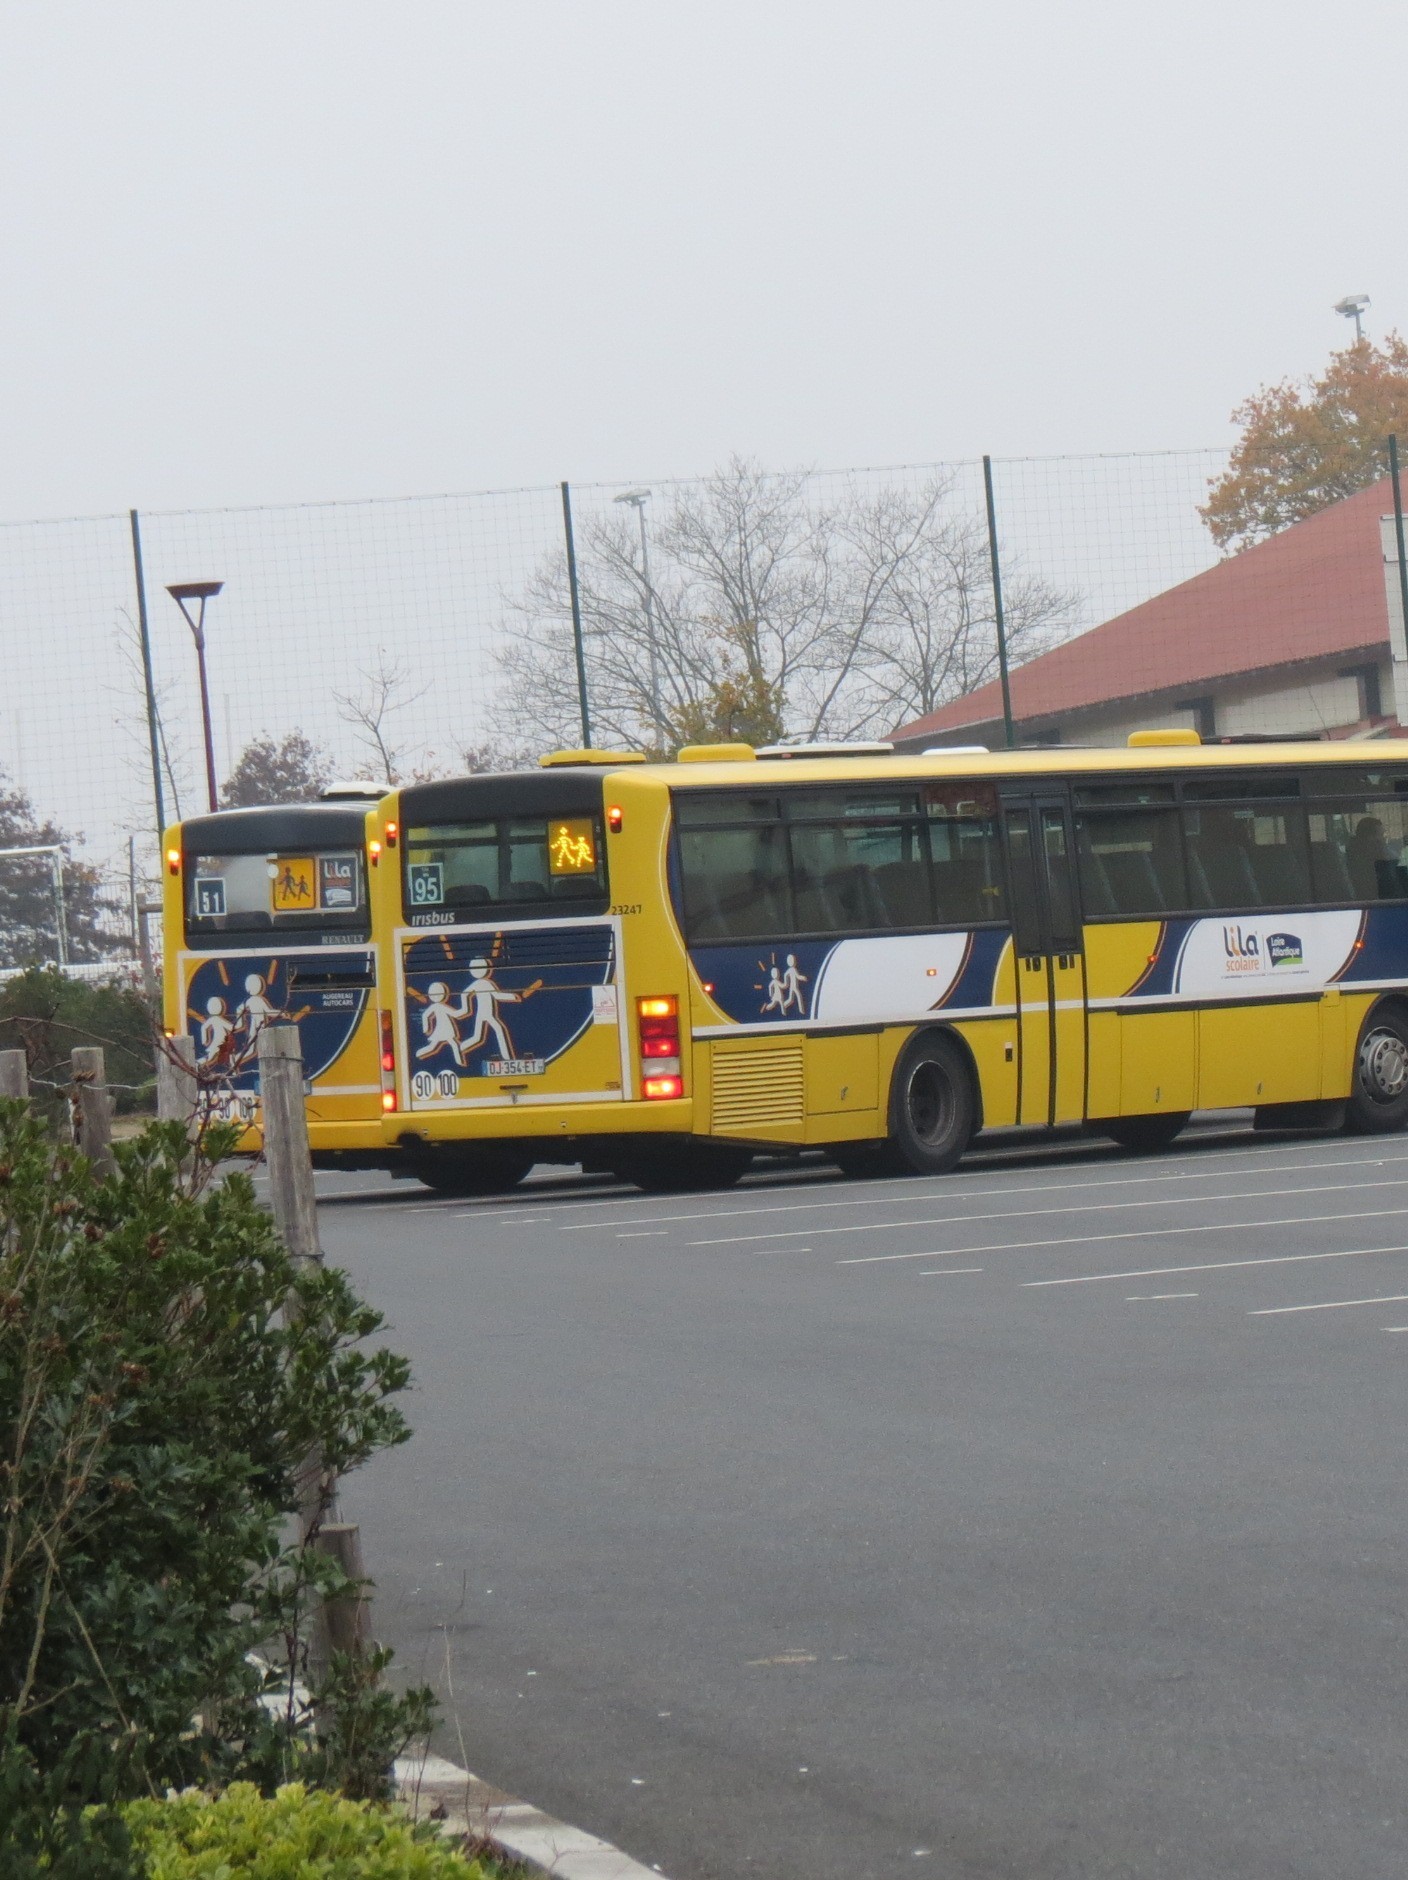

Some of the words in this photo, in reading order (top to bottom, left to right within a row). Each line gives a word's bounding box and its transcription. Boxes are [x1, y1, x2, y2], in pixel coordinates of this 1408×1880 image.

[324, 861, 350, 879] lila
[415, 877, 438, 901] 95
[202, 891, 220, 913] 51
[611, 904, 642, 915] 23247
[411, 911, 455, 927] irisbus
[321, 934, 365, 945] RENAULT
[1223, 925, 1259, 957] lila
[1226, 957, 1259, 972] scolaire
[322, 999, 354, 1007] AUTOCARS
[414, 1072, 432, 1098] 90
[437, 1070, 458, 1097] 100
